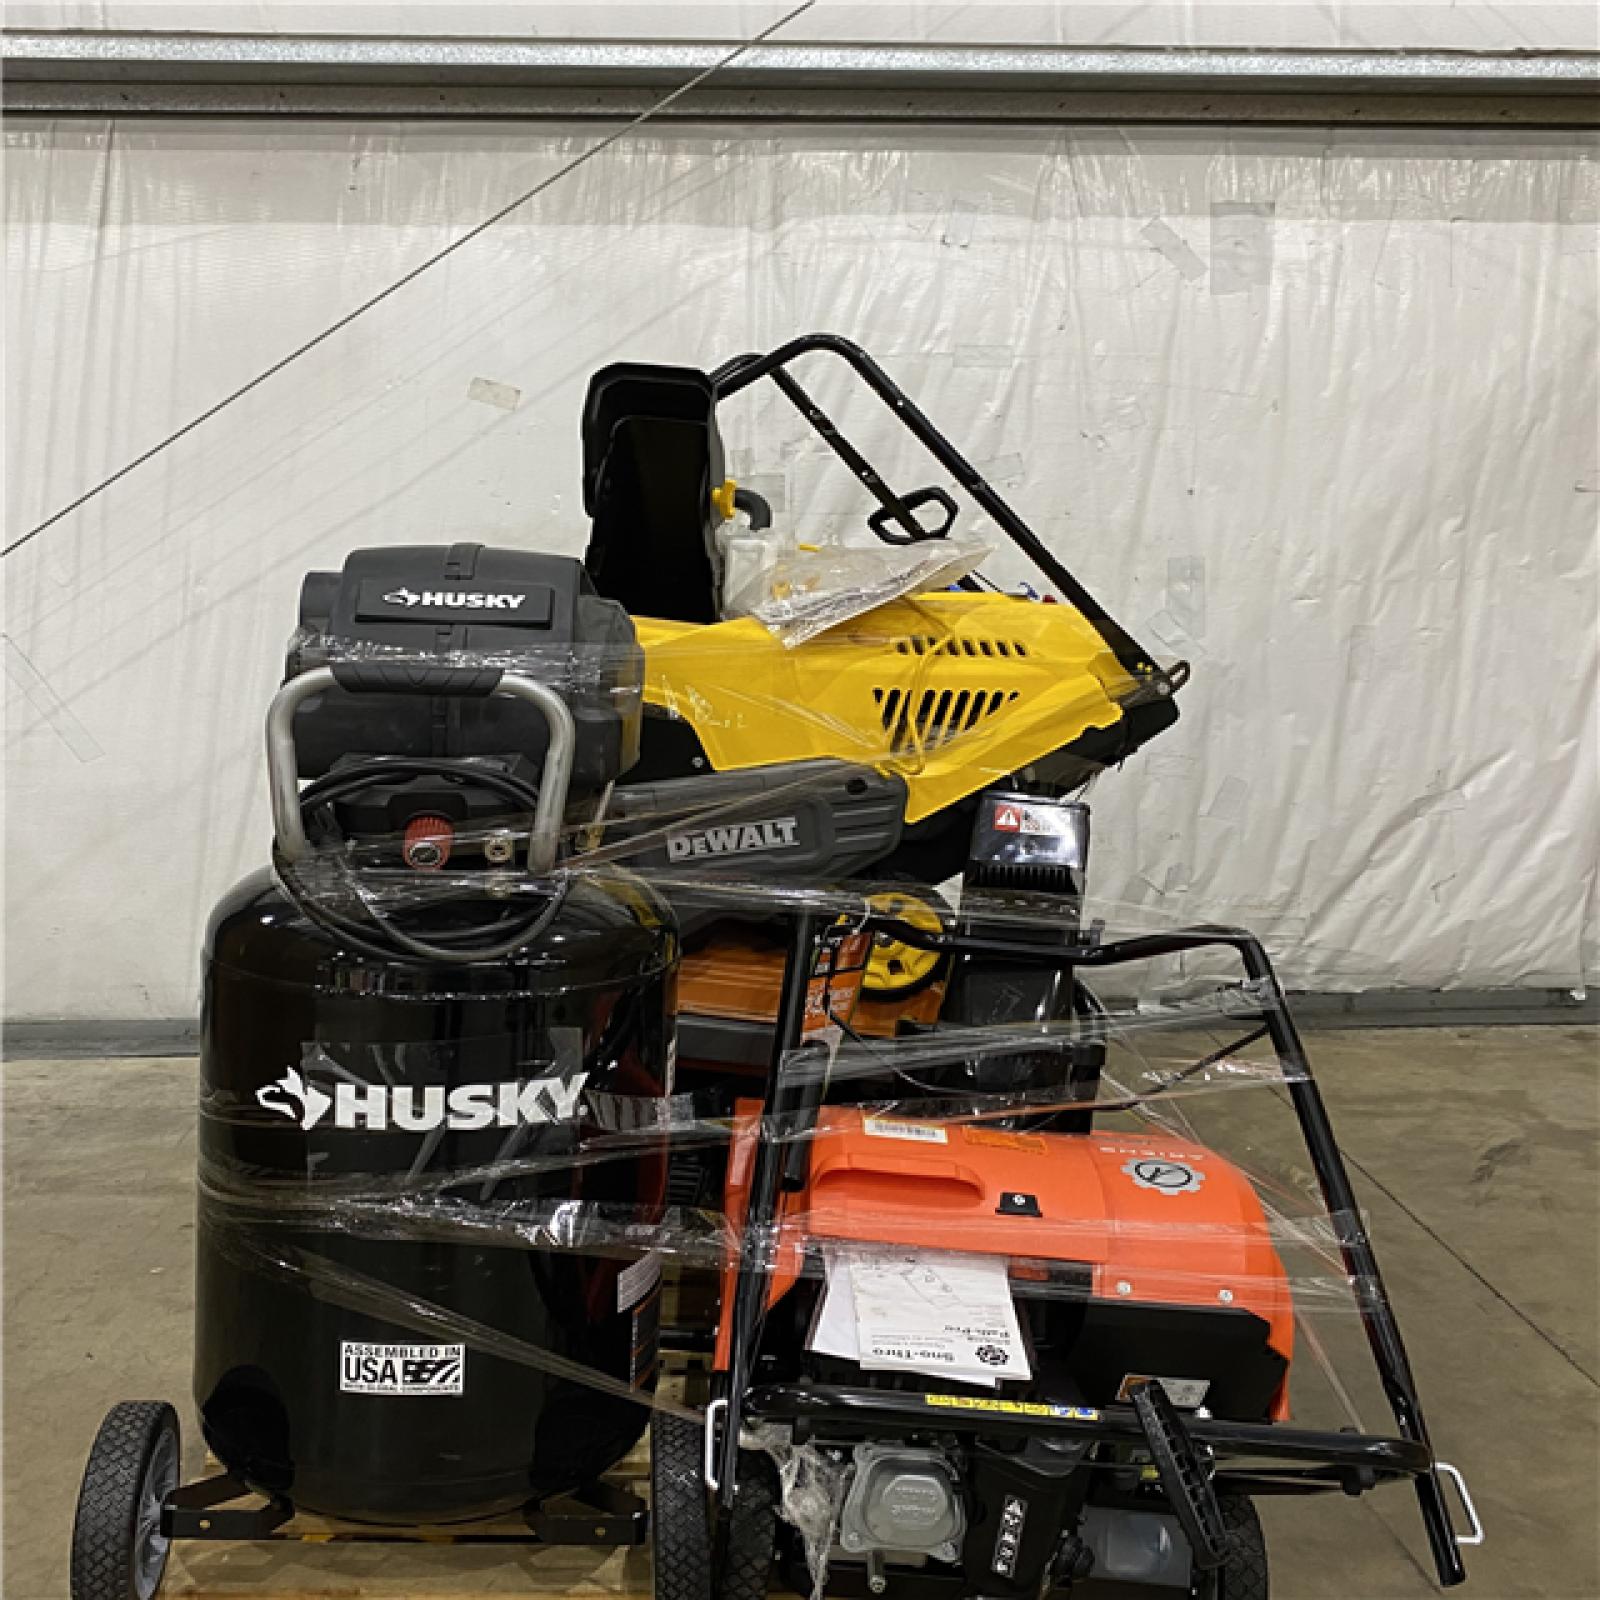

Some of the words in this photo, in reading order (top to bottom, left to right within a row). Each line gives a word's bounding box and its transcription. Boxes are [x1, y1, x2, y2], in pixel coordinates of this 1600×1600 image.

[422, 591, 526, 609] HUSKY
[334, 1072, 590, 1131] HUSKY
[344, 1344, 438, 1358] ASSEMBLED
[444, 1345, 461, 1358] IN
[344, 1357, 398, 1384] USA
